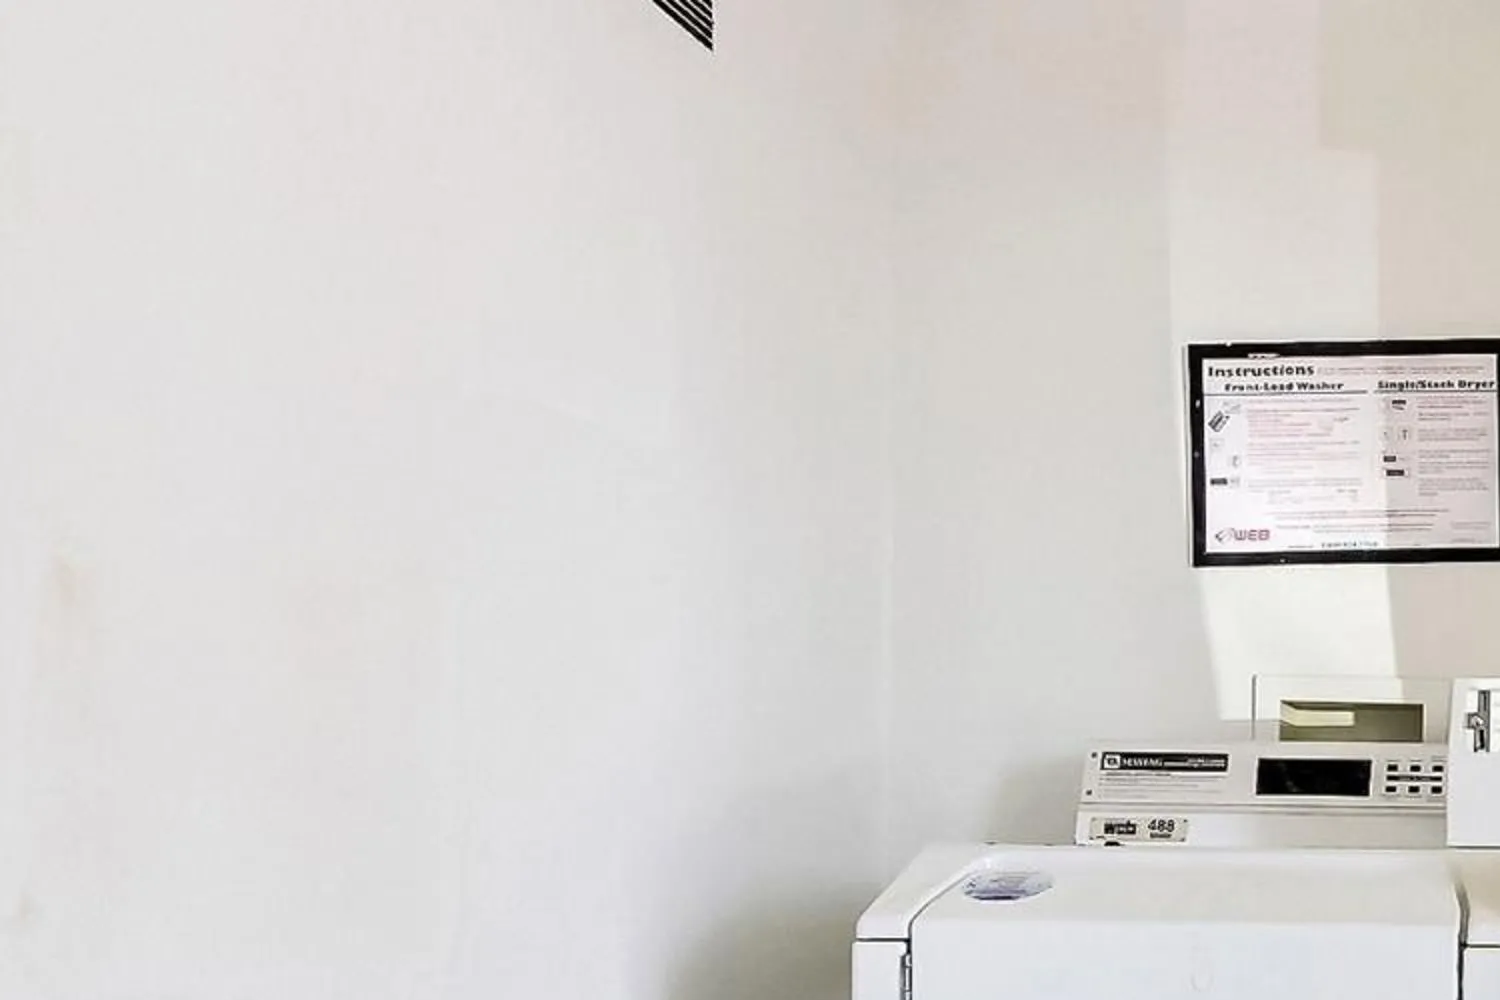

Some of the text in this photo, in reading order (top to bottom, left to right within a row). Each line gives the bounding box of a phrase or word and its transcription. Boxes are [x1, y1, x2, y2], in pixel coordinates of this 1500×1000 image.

[1207, 365, 1315, 377] Instructions
[1224, 381, 1345, 391] Front-Load Washer
[1457, 379, 1496, 390] Dryer
[1233, 528, 1271, 541] WEB
[1147, 818, 1176, 833] 488
